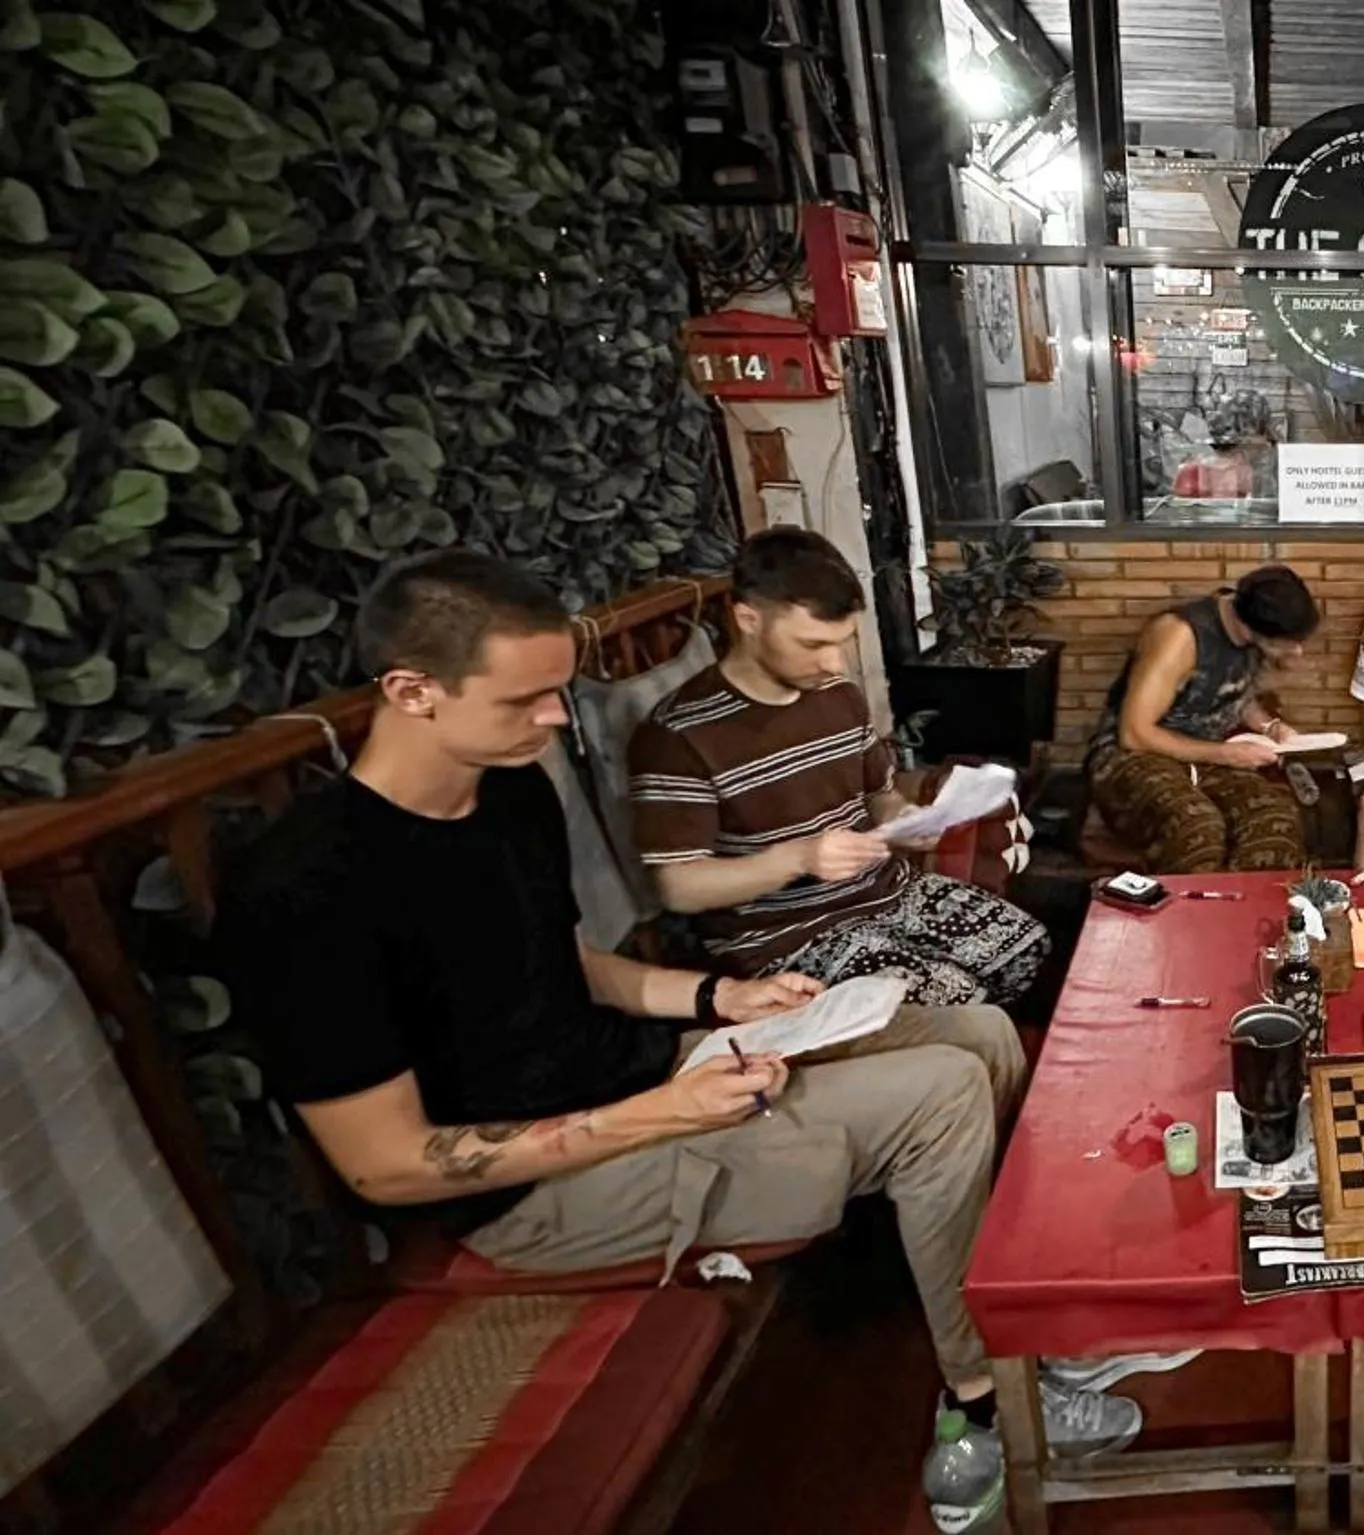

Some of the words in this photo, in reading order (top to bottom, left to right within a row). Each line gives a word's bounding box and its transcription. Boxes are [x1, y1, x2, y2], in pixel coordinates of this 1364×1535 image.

[1285, 466, 1309, 476] ONLY
[1311, 466, 1342, 476] HOSTEL
[1295, 481, 1338, 490] ALLOWED
[1339, 481, 1349, 490] IN
[1305, 496, 1332, 505] AFTER
